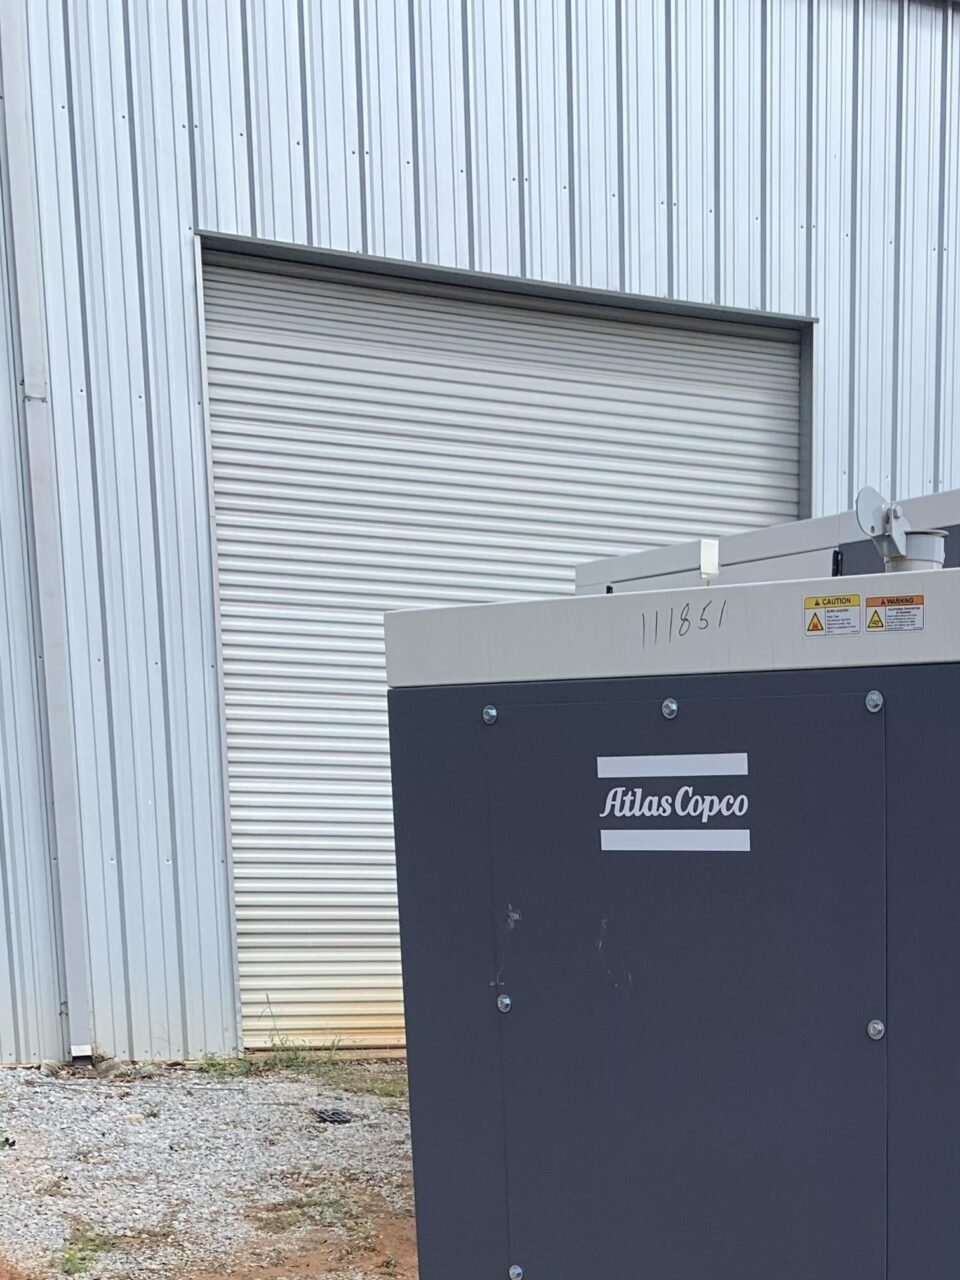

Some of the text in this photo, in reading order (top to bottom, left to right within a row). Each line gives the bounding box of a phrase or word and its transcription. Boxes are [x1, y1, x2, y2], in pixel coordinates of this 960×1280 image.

[822, 597, 851, 606] CAUTION
[886, 597, 914, 605] WARNING
[641, 599, 727, 649] 111851
